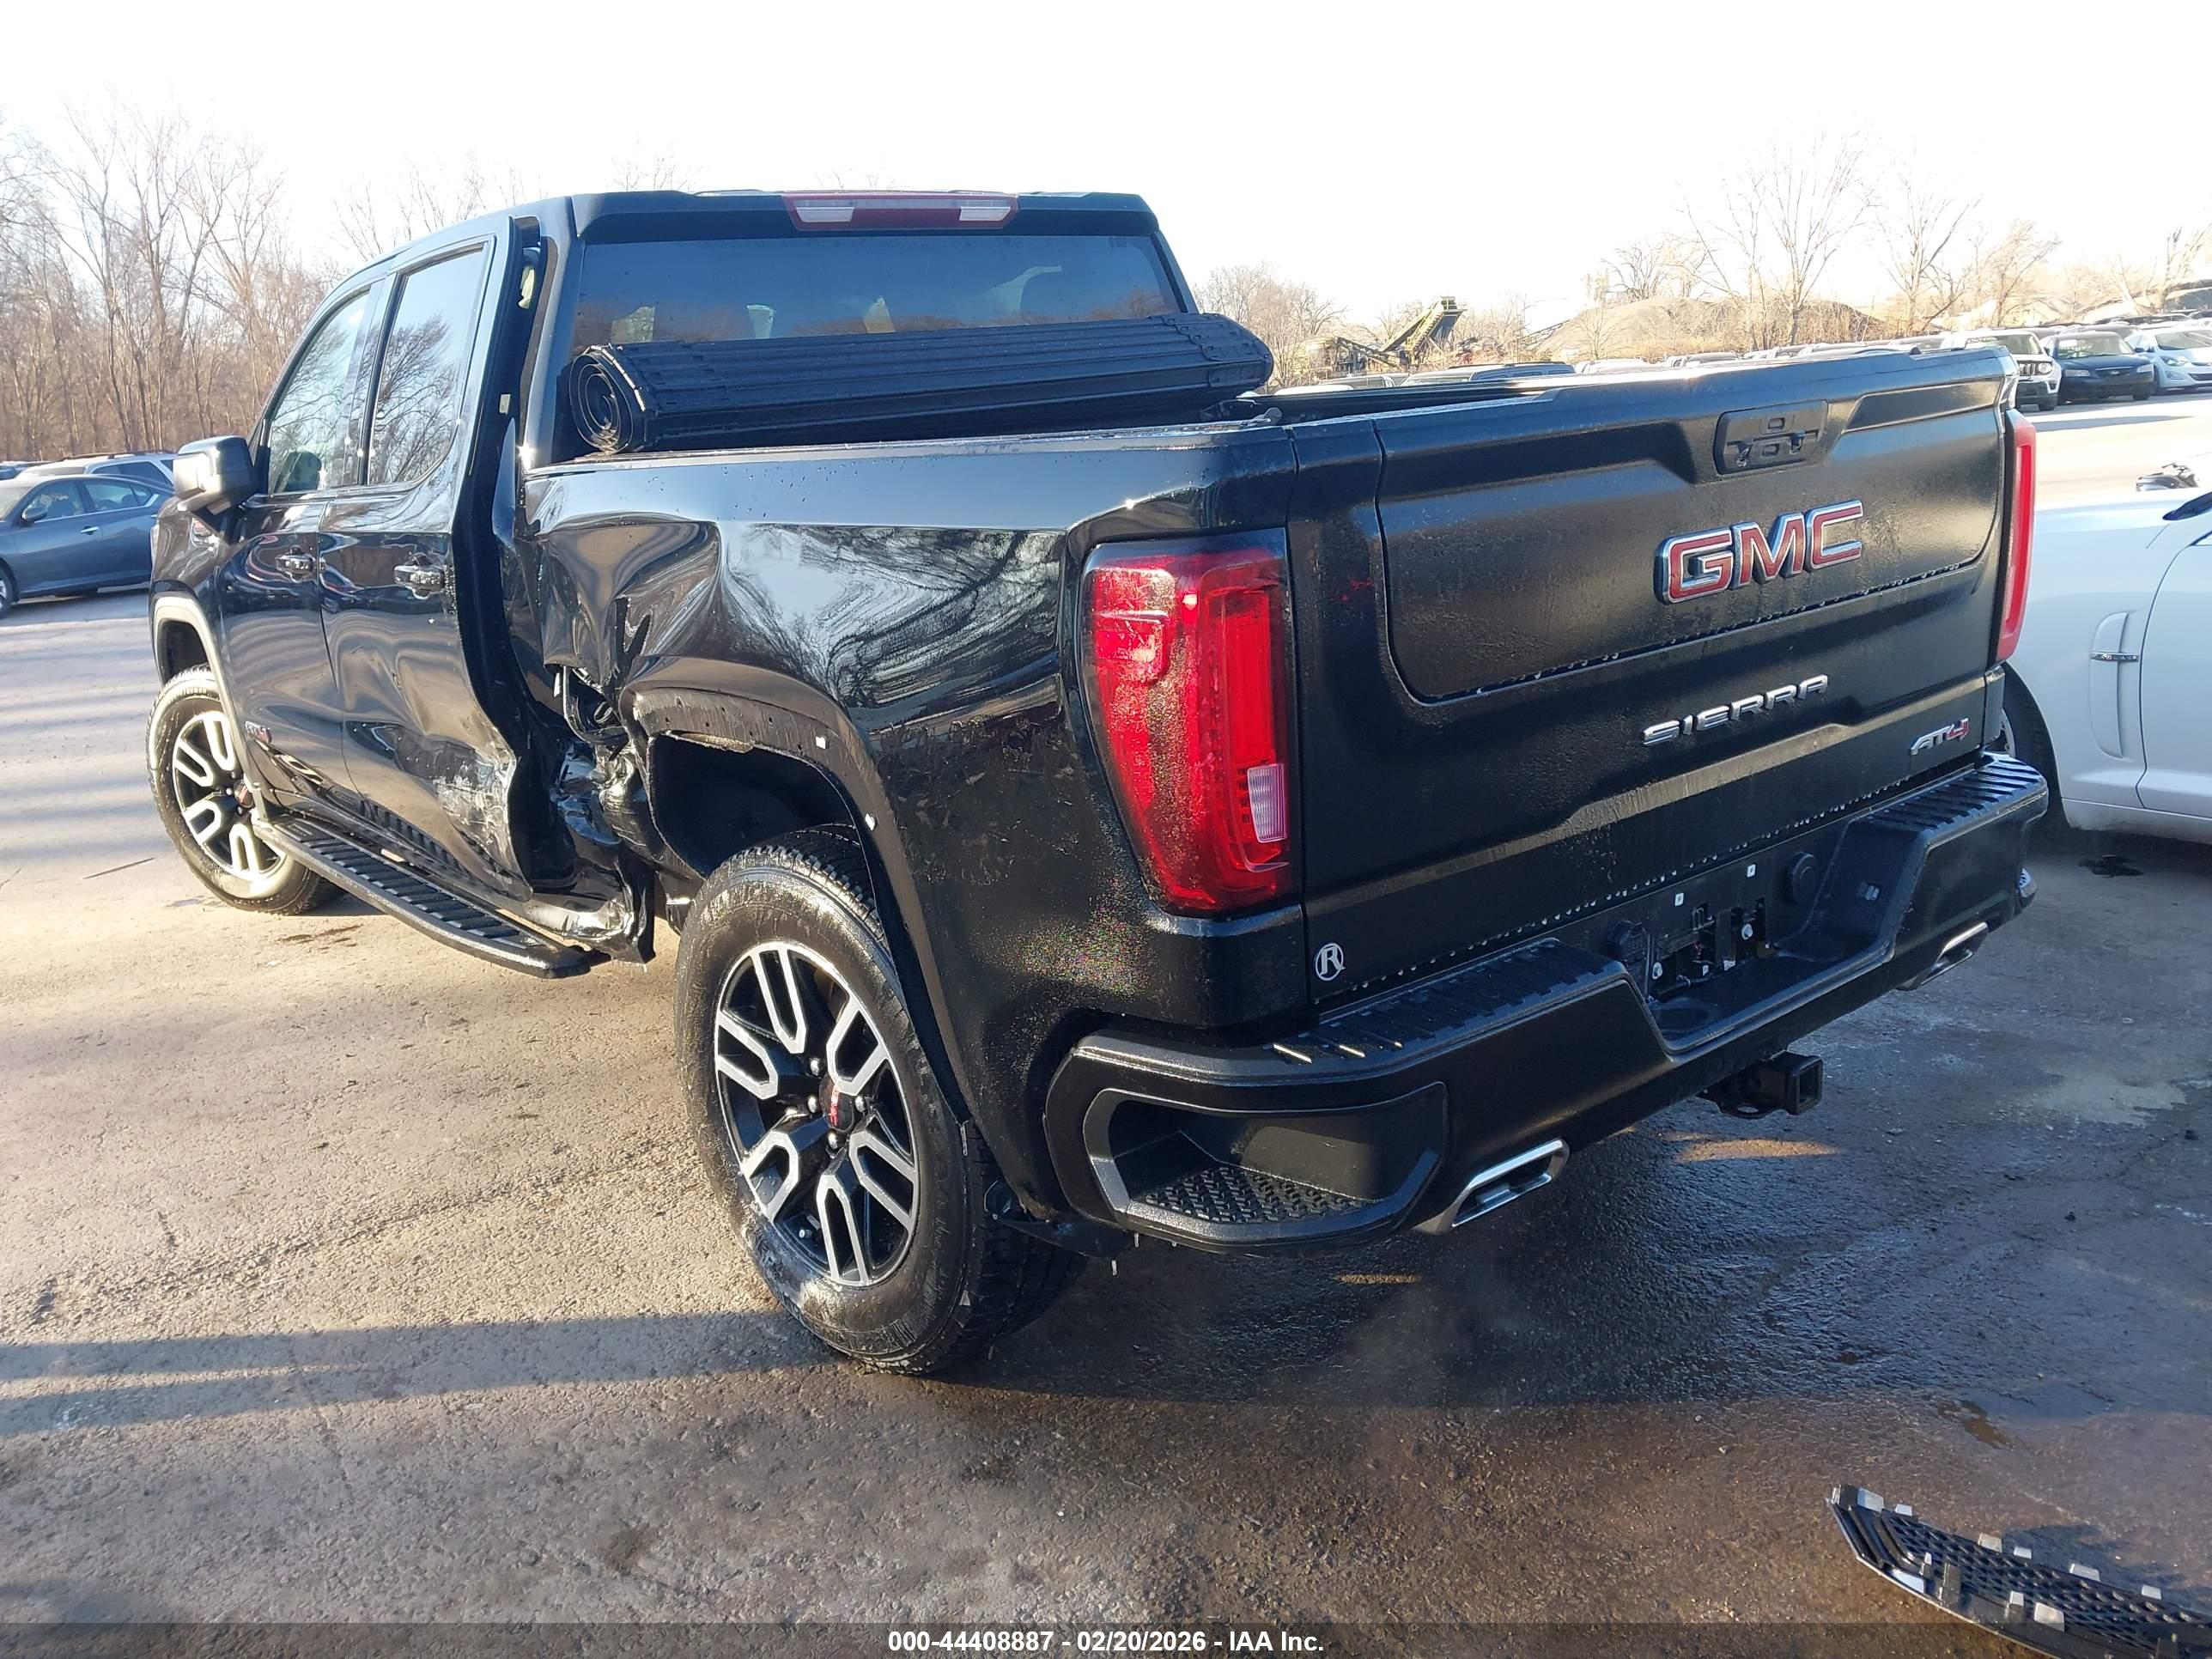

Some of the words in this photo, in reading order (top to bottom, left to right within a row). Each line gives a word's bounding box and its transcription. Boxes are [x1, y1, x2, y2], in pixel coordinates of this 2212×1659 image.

[1654, 499, 1863, 604] GMC
[1643, 674, 1829, 746] SIERRA
[1910, 717, 1969, 756] AT4
